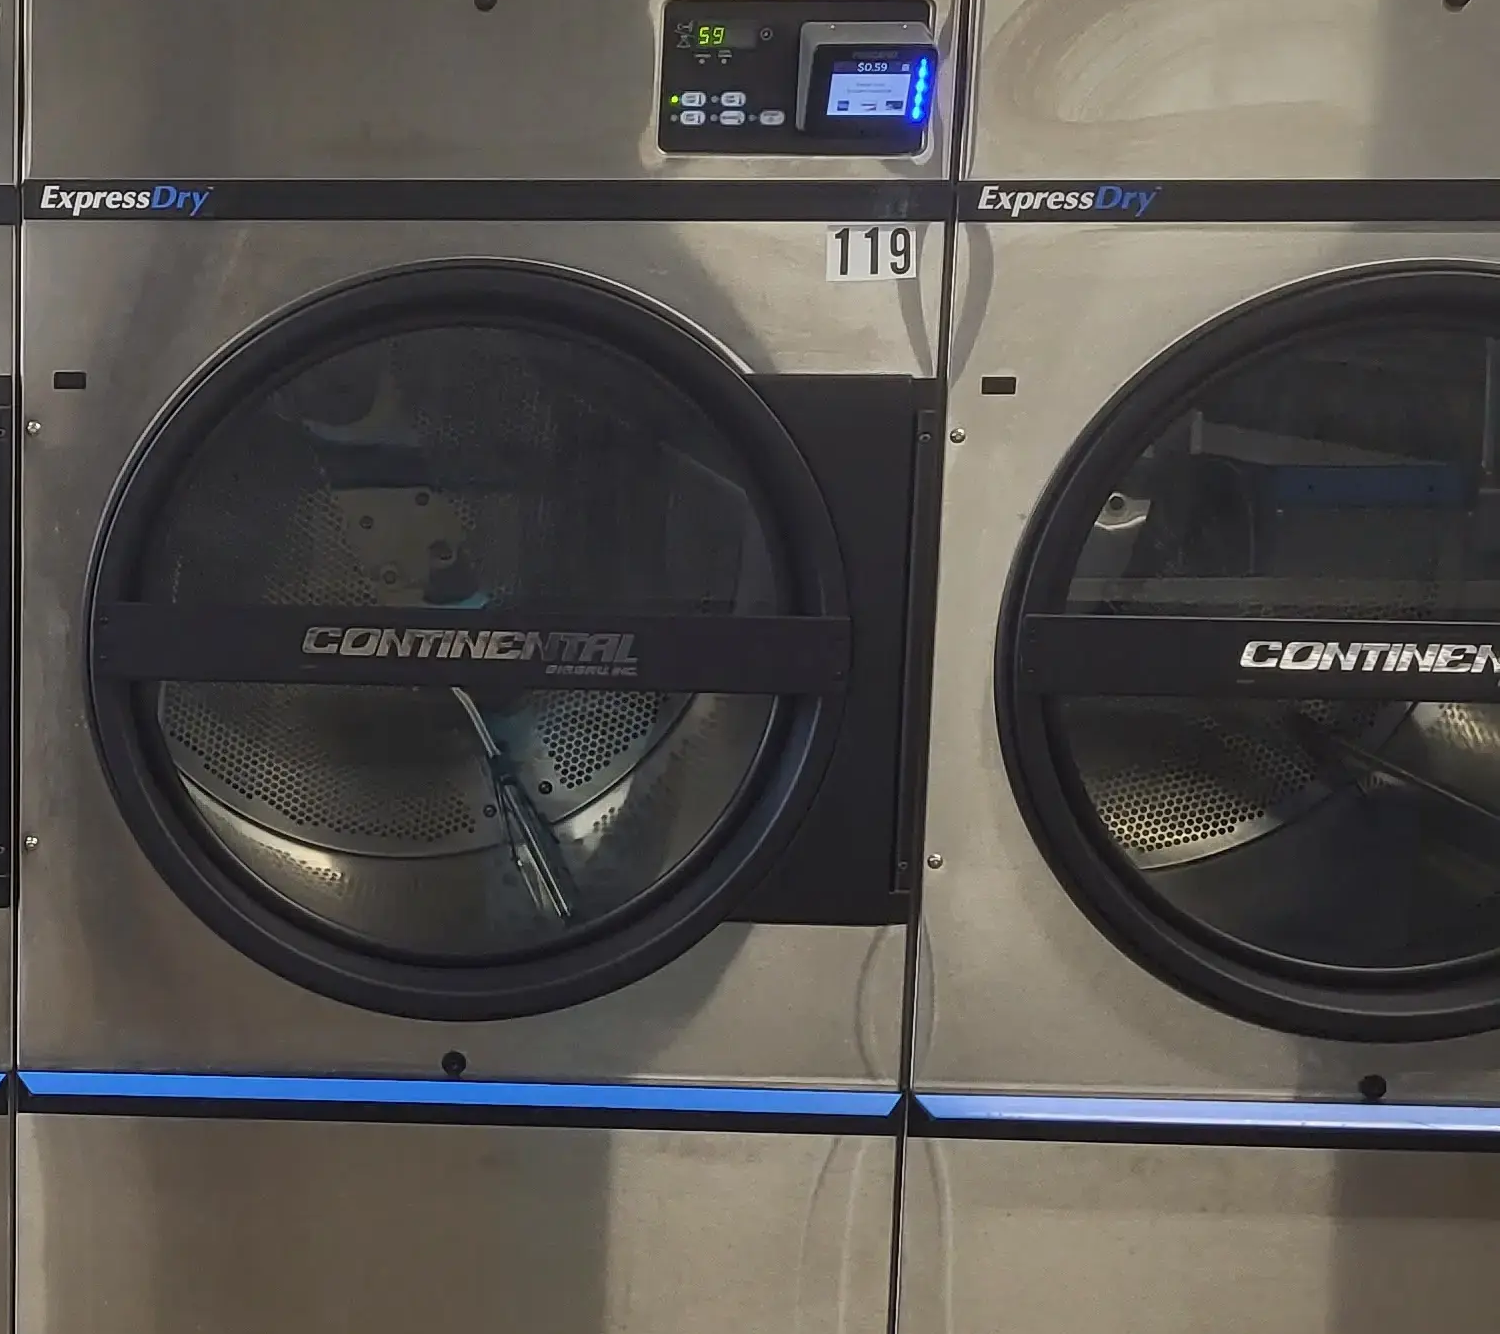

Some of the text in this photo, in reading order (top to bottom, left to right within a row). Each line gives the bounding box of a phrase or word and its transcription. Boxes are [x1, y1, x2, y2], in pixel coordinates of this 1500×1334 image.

[698, 26, 725, 45] 59
[857, 62, 888, 73] $0.59
[40, 185, 209, 216] ExpressDry
[977, 185, 1156, 217] ExpressDry
[834, 227, 911, 276] 119
[301, 626, 639, 664] CONTINENTAL
